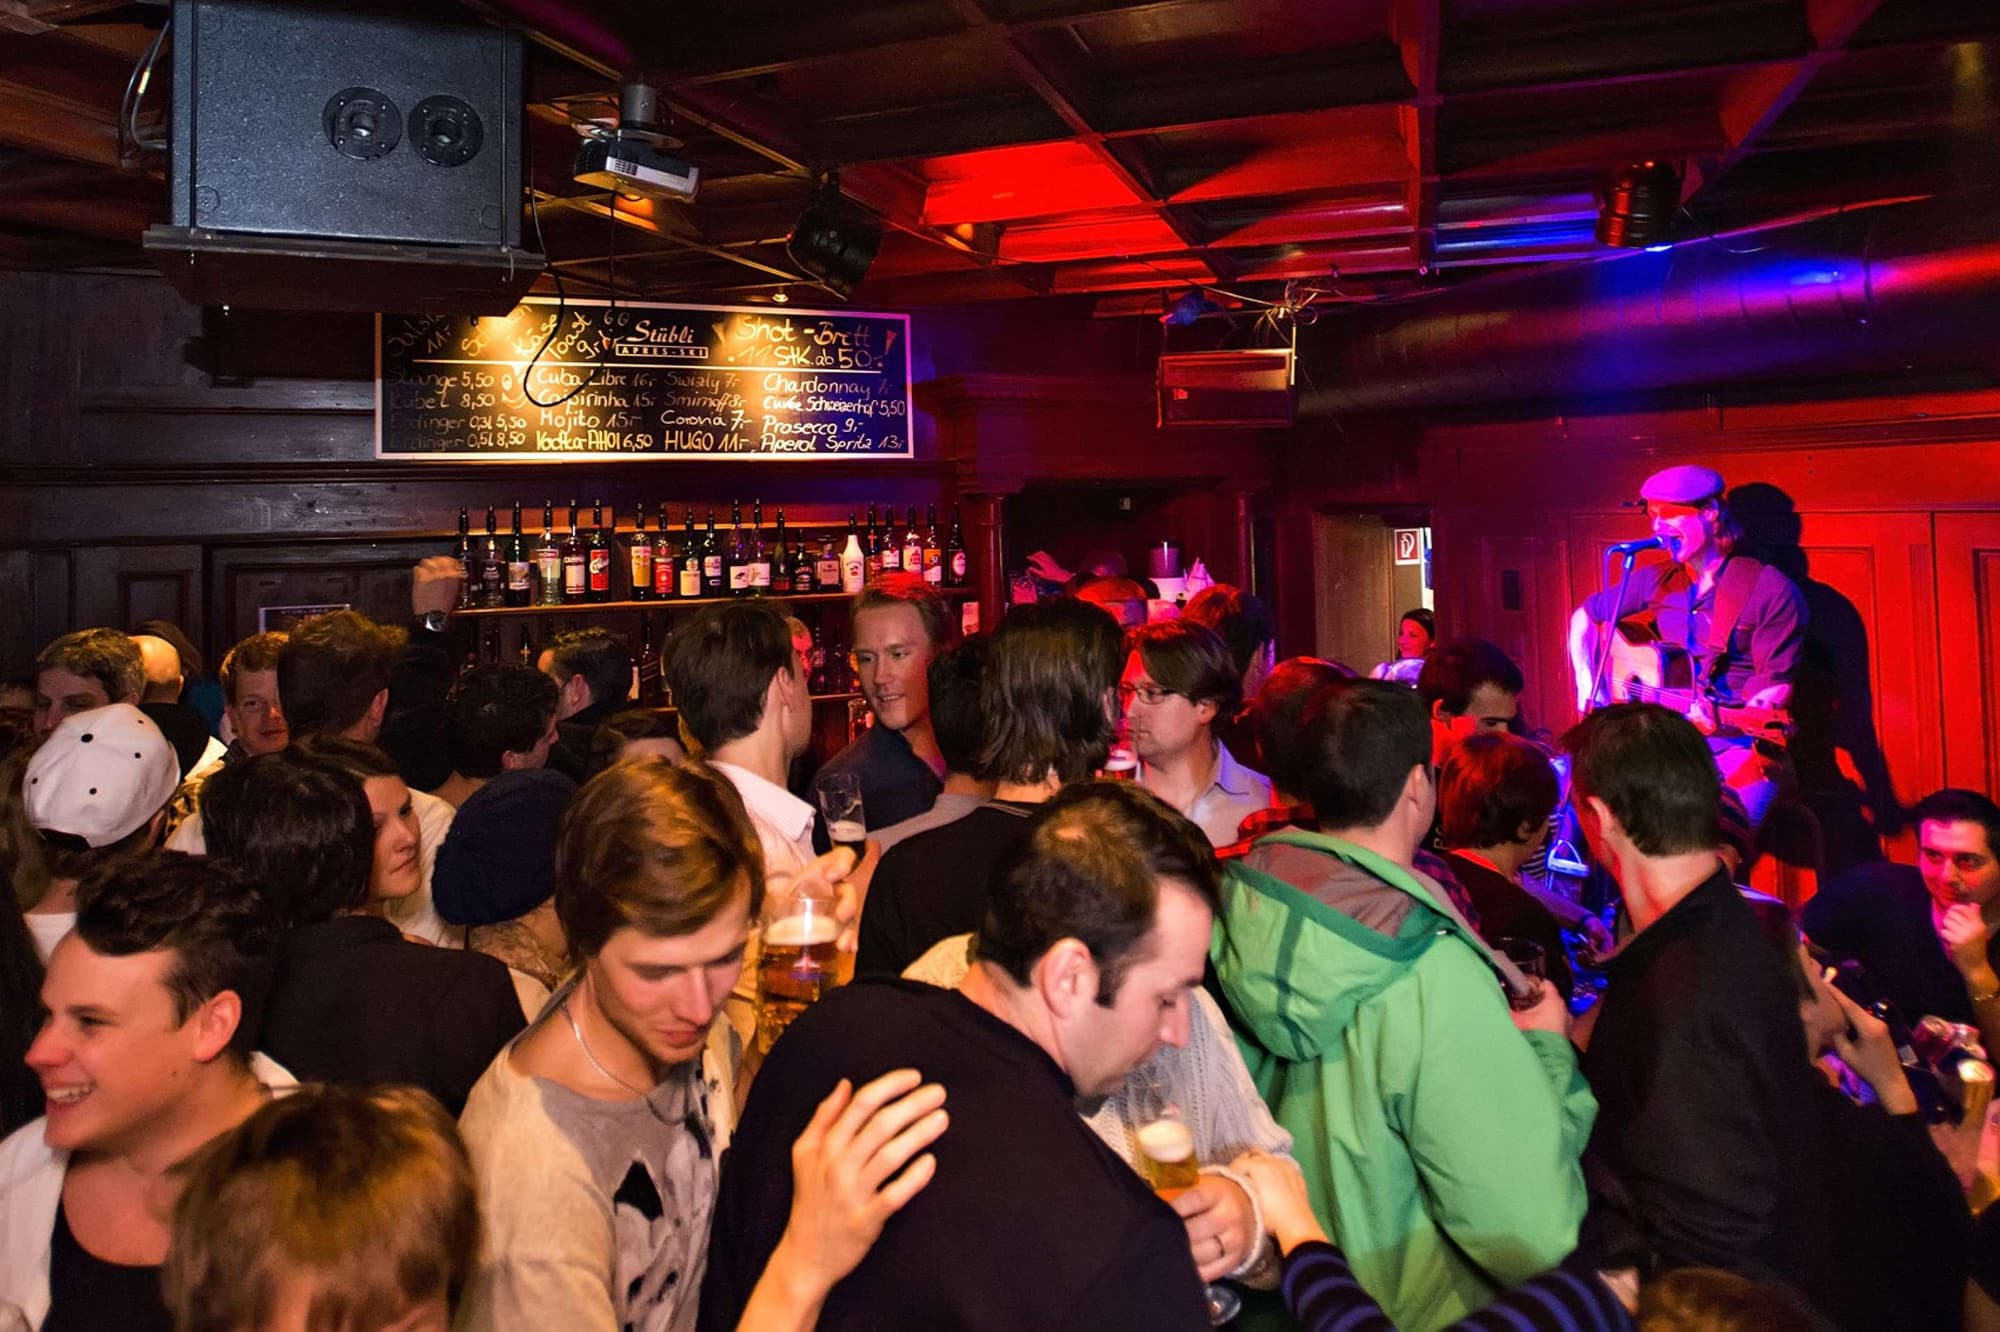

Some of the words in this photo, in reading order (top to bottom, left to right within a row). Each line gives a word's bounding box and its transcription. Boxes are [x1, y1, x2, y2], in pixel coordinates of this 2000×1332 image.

[547, 311, 592, 360] Toast
[626, 319, 696, 344] Stübli
[735, 314, 797, 343] Shot
[815, 349, 835, 367] ab
[461, 371, 495, 391] 5,50
[536, 367, 584, 386] Cuba
[587, 368, 628, 386] Libre
[763, 372, 870, 400] Chardonnay
[460, 393, 496, 411] 8,50
[537, 388, 631, 415] Caipirinha
[879, 400, 906, 418] 5,50
[496, 413, 528, 433] 5,50
[540, 408, 600, 435] Mojito
[660, 409, 727, 426] Corona
[762, 414, 838, 436] Prosecco
[496, 431, 527, 449] 8,50
[623, 433, 653, 452] 6,50
[664, 430, 714, 452] HUGO
[760, 432, 818, 455] Aperol
[825, 432, 873, 453] Spritz
